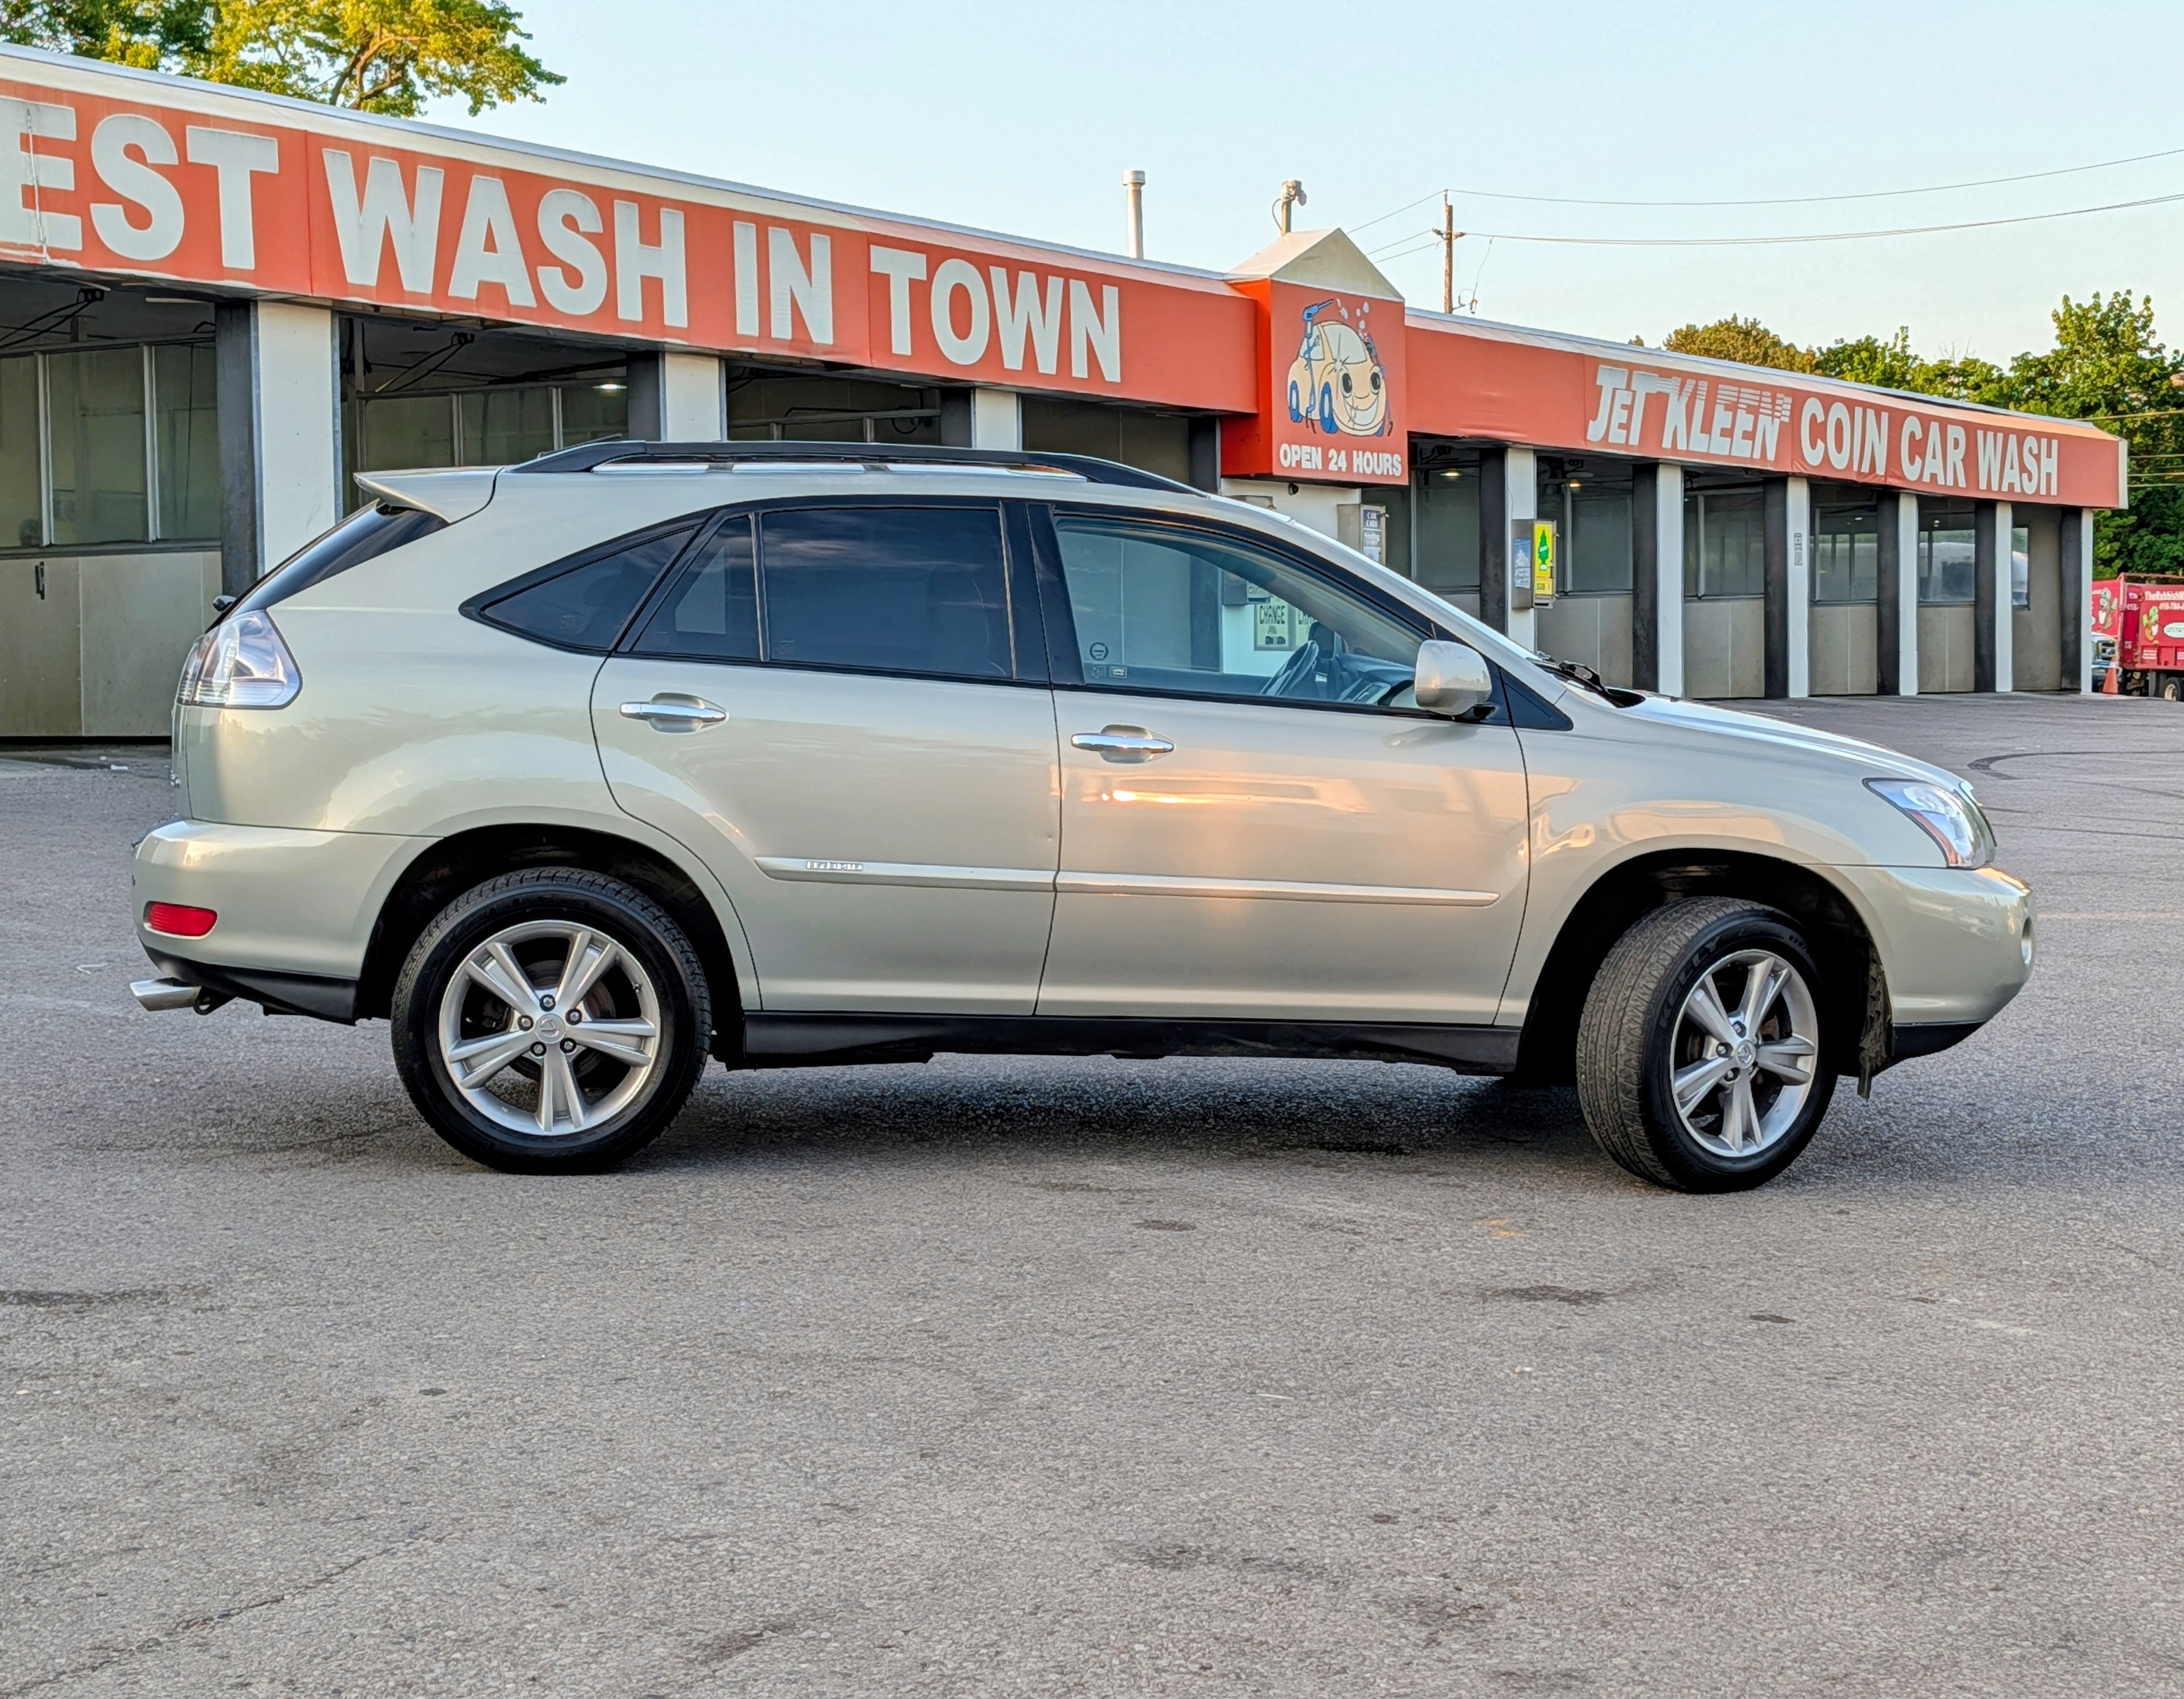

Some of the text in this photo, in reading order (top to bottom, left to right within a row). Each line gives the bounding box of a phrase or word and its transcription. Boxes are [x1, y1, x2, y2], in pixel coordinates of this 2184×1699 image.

[0, 96, 1121, 382] EST WASH IN TOWN
[1279, 443, 1402, 476] OPEN 24 HOURS
[1587, 365, 2058, 496] JET KLEEN COIN CAR WASH
[1658, 935, 1721, 1029] KELLY
